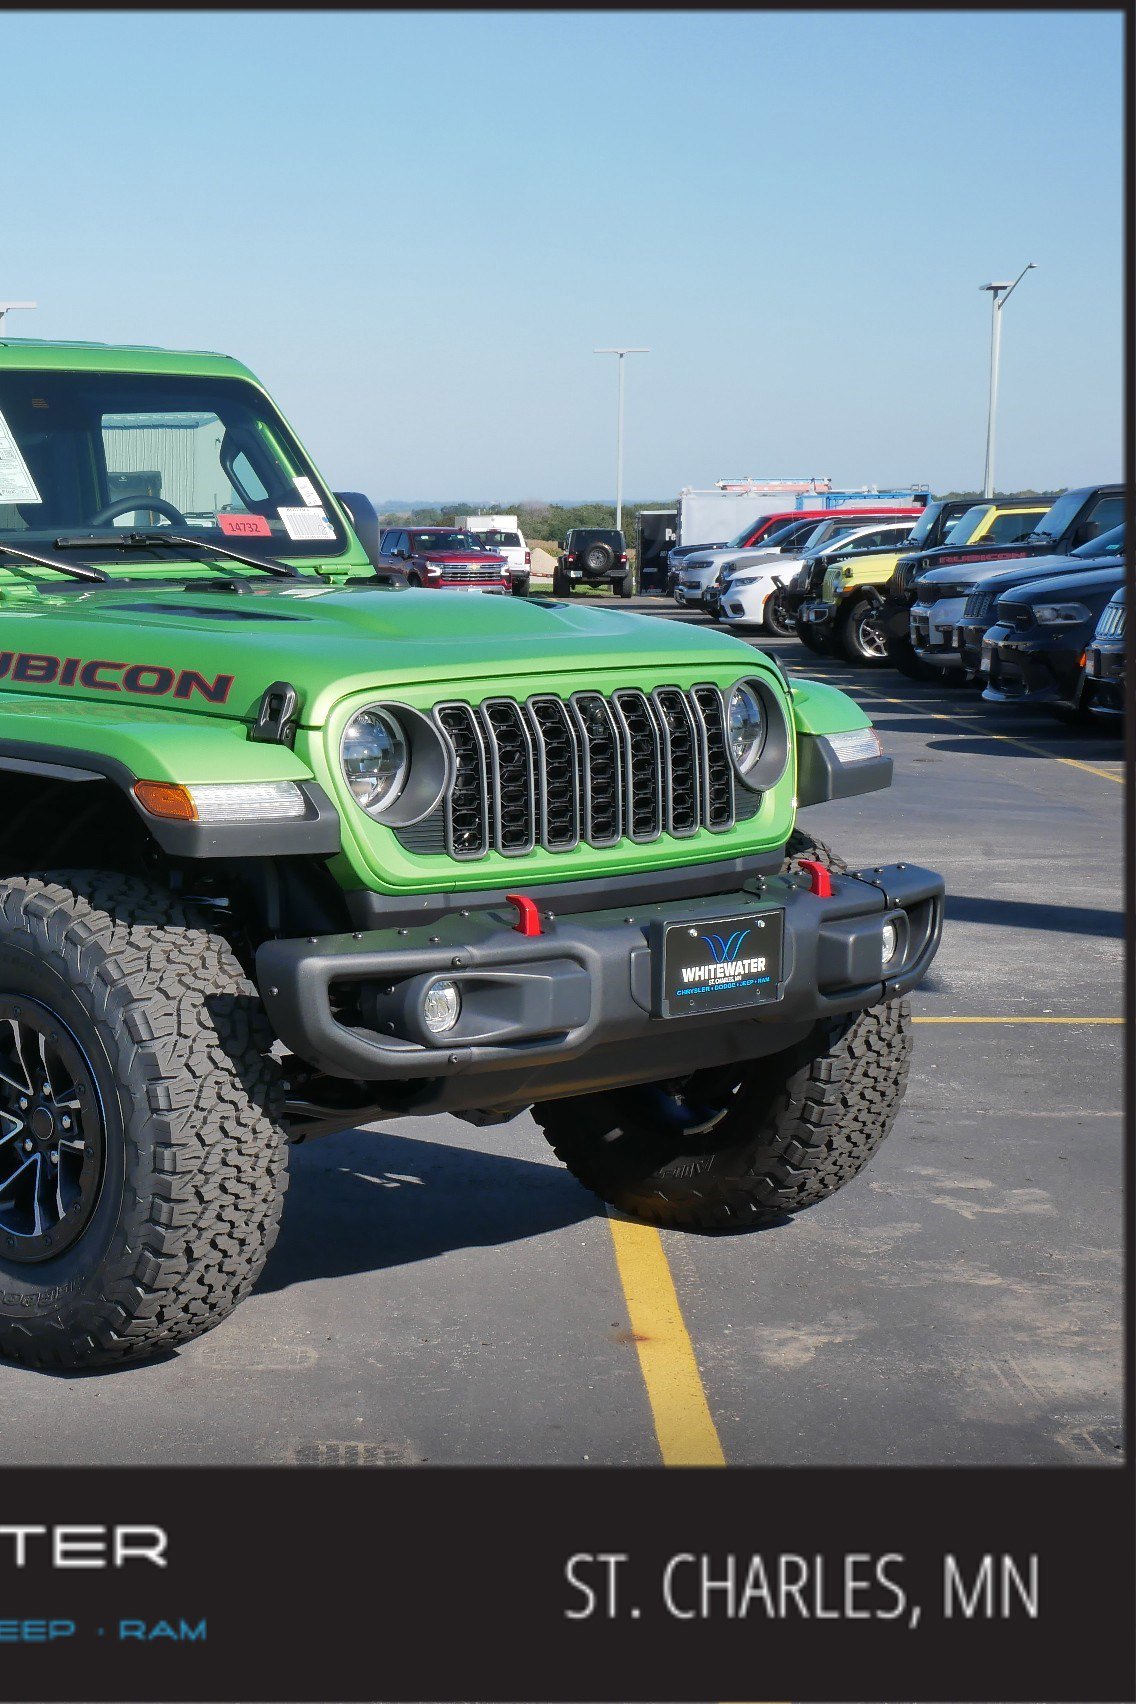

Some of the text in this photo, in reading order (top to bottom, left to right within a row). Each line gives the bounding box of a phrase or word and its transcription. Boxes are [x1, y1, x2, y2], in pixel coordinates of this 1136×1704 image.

[228, 522, 261, 533] 14732
[682, 957, 766, 982] WHITEWATER
[676, 986, 710, 996] CHRYSLER
